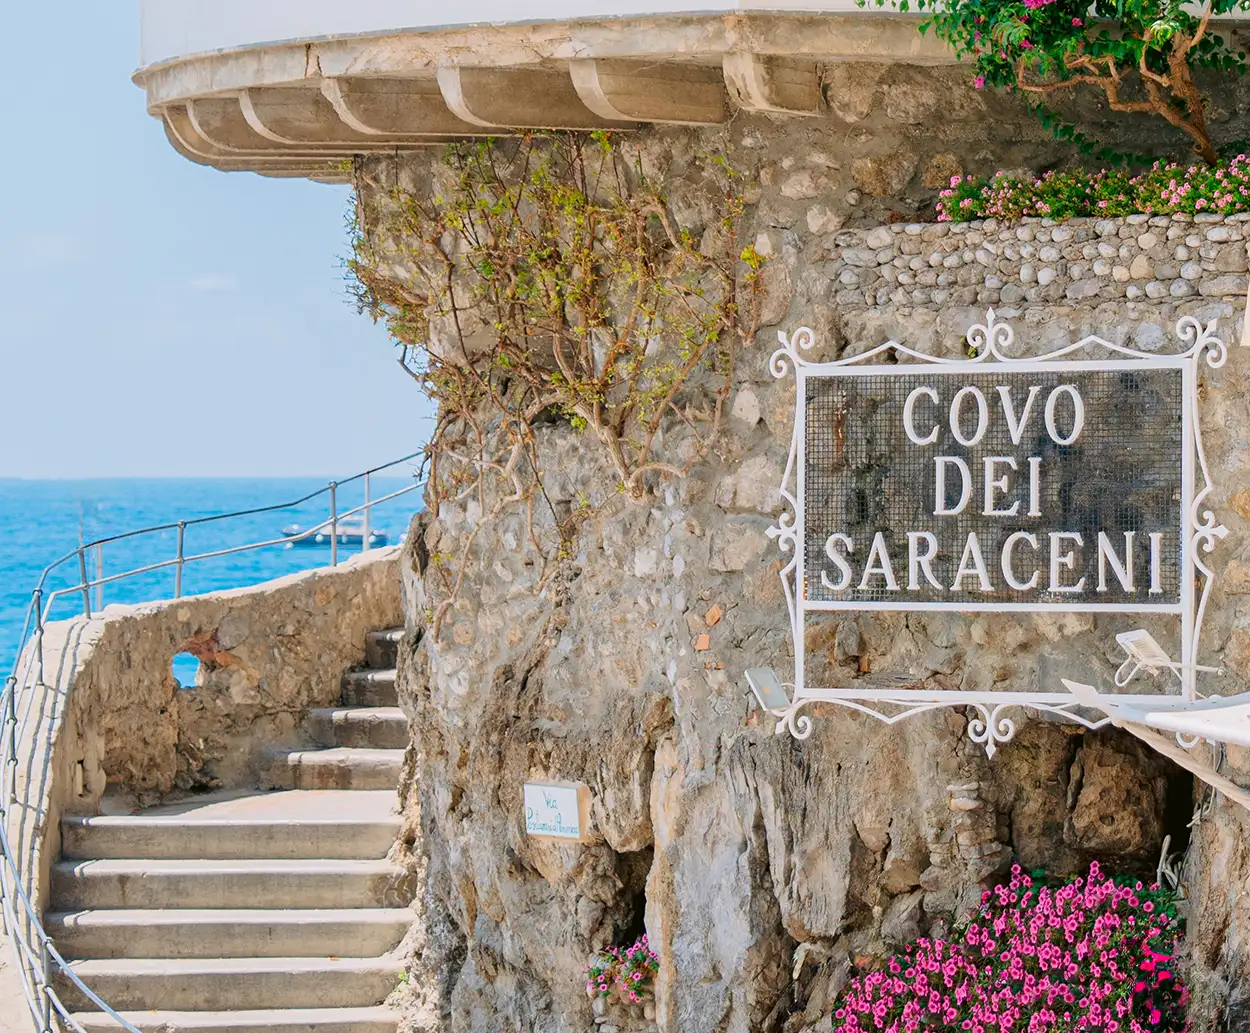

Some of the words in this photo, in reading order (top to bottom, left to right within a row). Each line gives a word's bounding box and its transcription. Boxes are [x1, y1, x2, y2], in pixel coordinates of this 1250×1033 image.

[903, 384, 1085, 446] COVO
[933, 456, 1042, 517] DEI
[820, 530, 1163, 593] SARACENI
